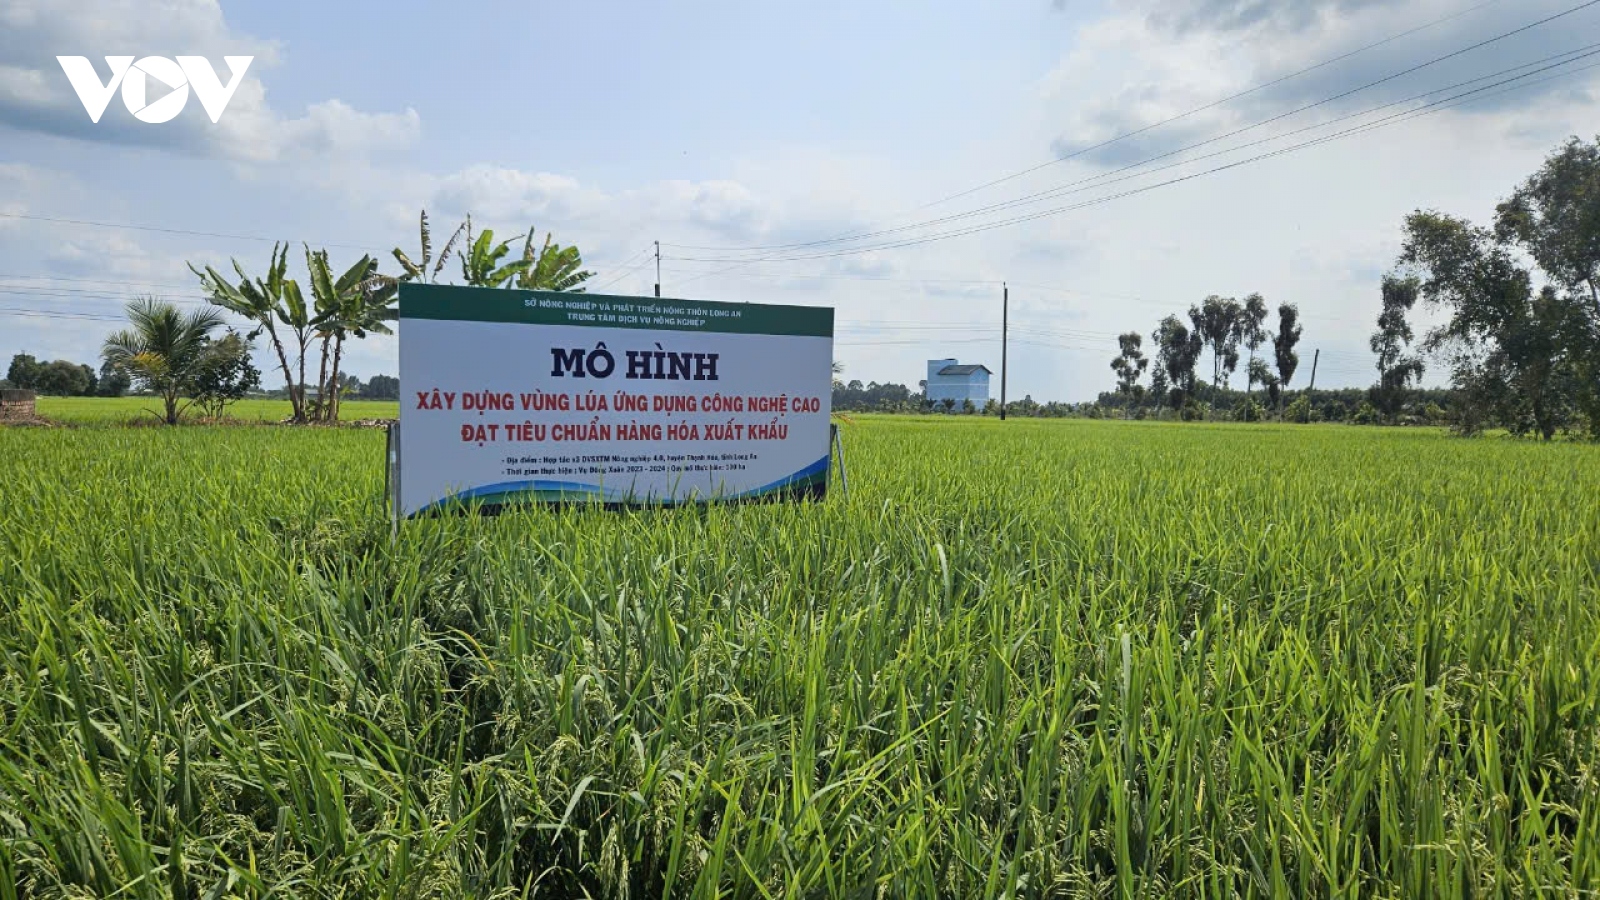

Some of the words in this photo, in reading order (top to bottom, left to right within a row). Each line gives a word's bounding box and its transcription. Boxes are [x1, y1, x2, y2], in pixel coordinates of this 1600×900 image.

[524, 297, 537, 307] SỞ
[540, 299, 563, 308] NÔNG
[566, 301, 597, 311] NGHIỆP
[599, 302, 610, 311] VÀ
[613, 303, 634, 312] PHÁT
[638, 304, 660, 314] TRIỂN
[664, 306, 685, 315] NÔNG
[687, 307, 709, 316] THÔN
[710, 309, 729, 317] LONG
[567, 313, 596, 321] TRUNG
[598, 313, 616, 322] TÂM
[618, 315, 637, 325] DỊCH
[640, 316, 651, 325] VỤ
[654, 317, 675, 326] NÔNG
[677, 318, 706, 327] NGHIỆP
[551, 341, 615, 379] MÔ
[625, 342, 719, 381] HÌNH
[416, 388, 456, 410] XÂY
[462, 389, 515, 416] DỰNG
[520, 388, 570, 411] VÙNG
[575, 390, 608, 411] LÚA
[613, 390, 648, 412] ỨNG
[653, 395, 697, 416] DỤNG
[701, 392, 743, 413] CÔNG
[748, 393, 788, 417] NGHỆ
[792, 397, 820, 413] CAO
[461, 424, 499, 447] ĐẠT
[505, 420, 546, 441] TIÊU
[551, 415, 611, 441] CHUẨN
[616, 420, 662, 441] HÀNG
[667, 420, 700, 440] HÓA
[703, 418, 744, 441] XUẤT
[748, 417, 788, 440] KHẨU
